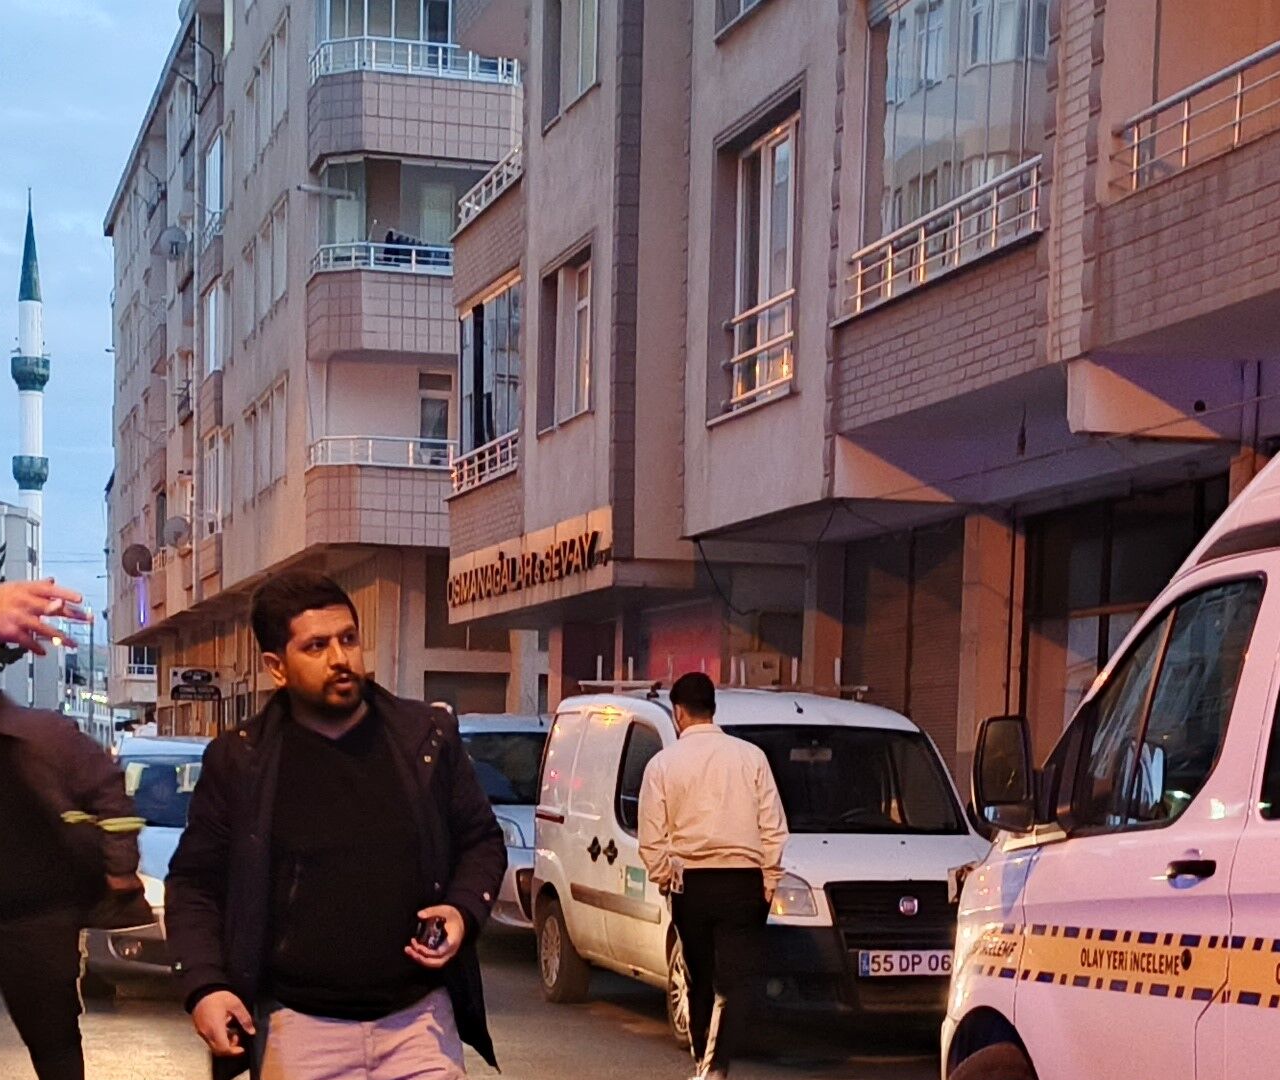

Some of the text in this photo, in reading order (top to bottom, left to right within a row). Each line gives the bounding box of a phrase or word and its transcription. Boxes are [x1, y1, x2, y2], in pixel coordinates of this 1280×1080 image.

[871, 954, 894, 973] 55
[899, 954, 922, 973] DP
[1080, 947, 1105, 969] OLAY
